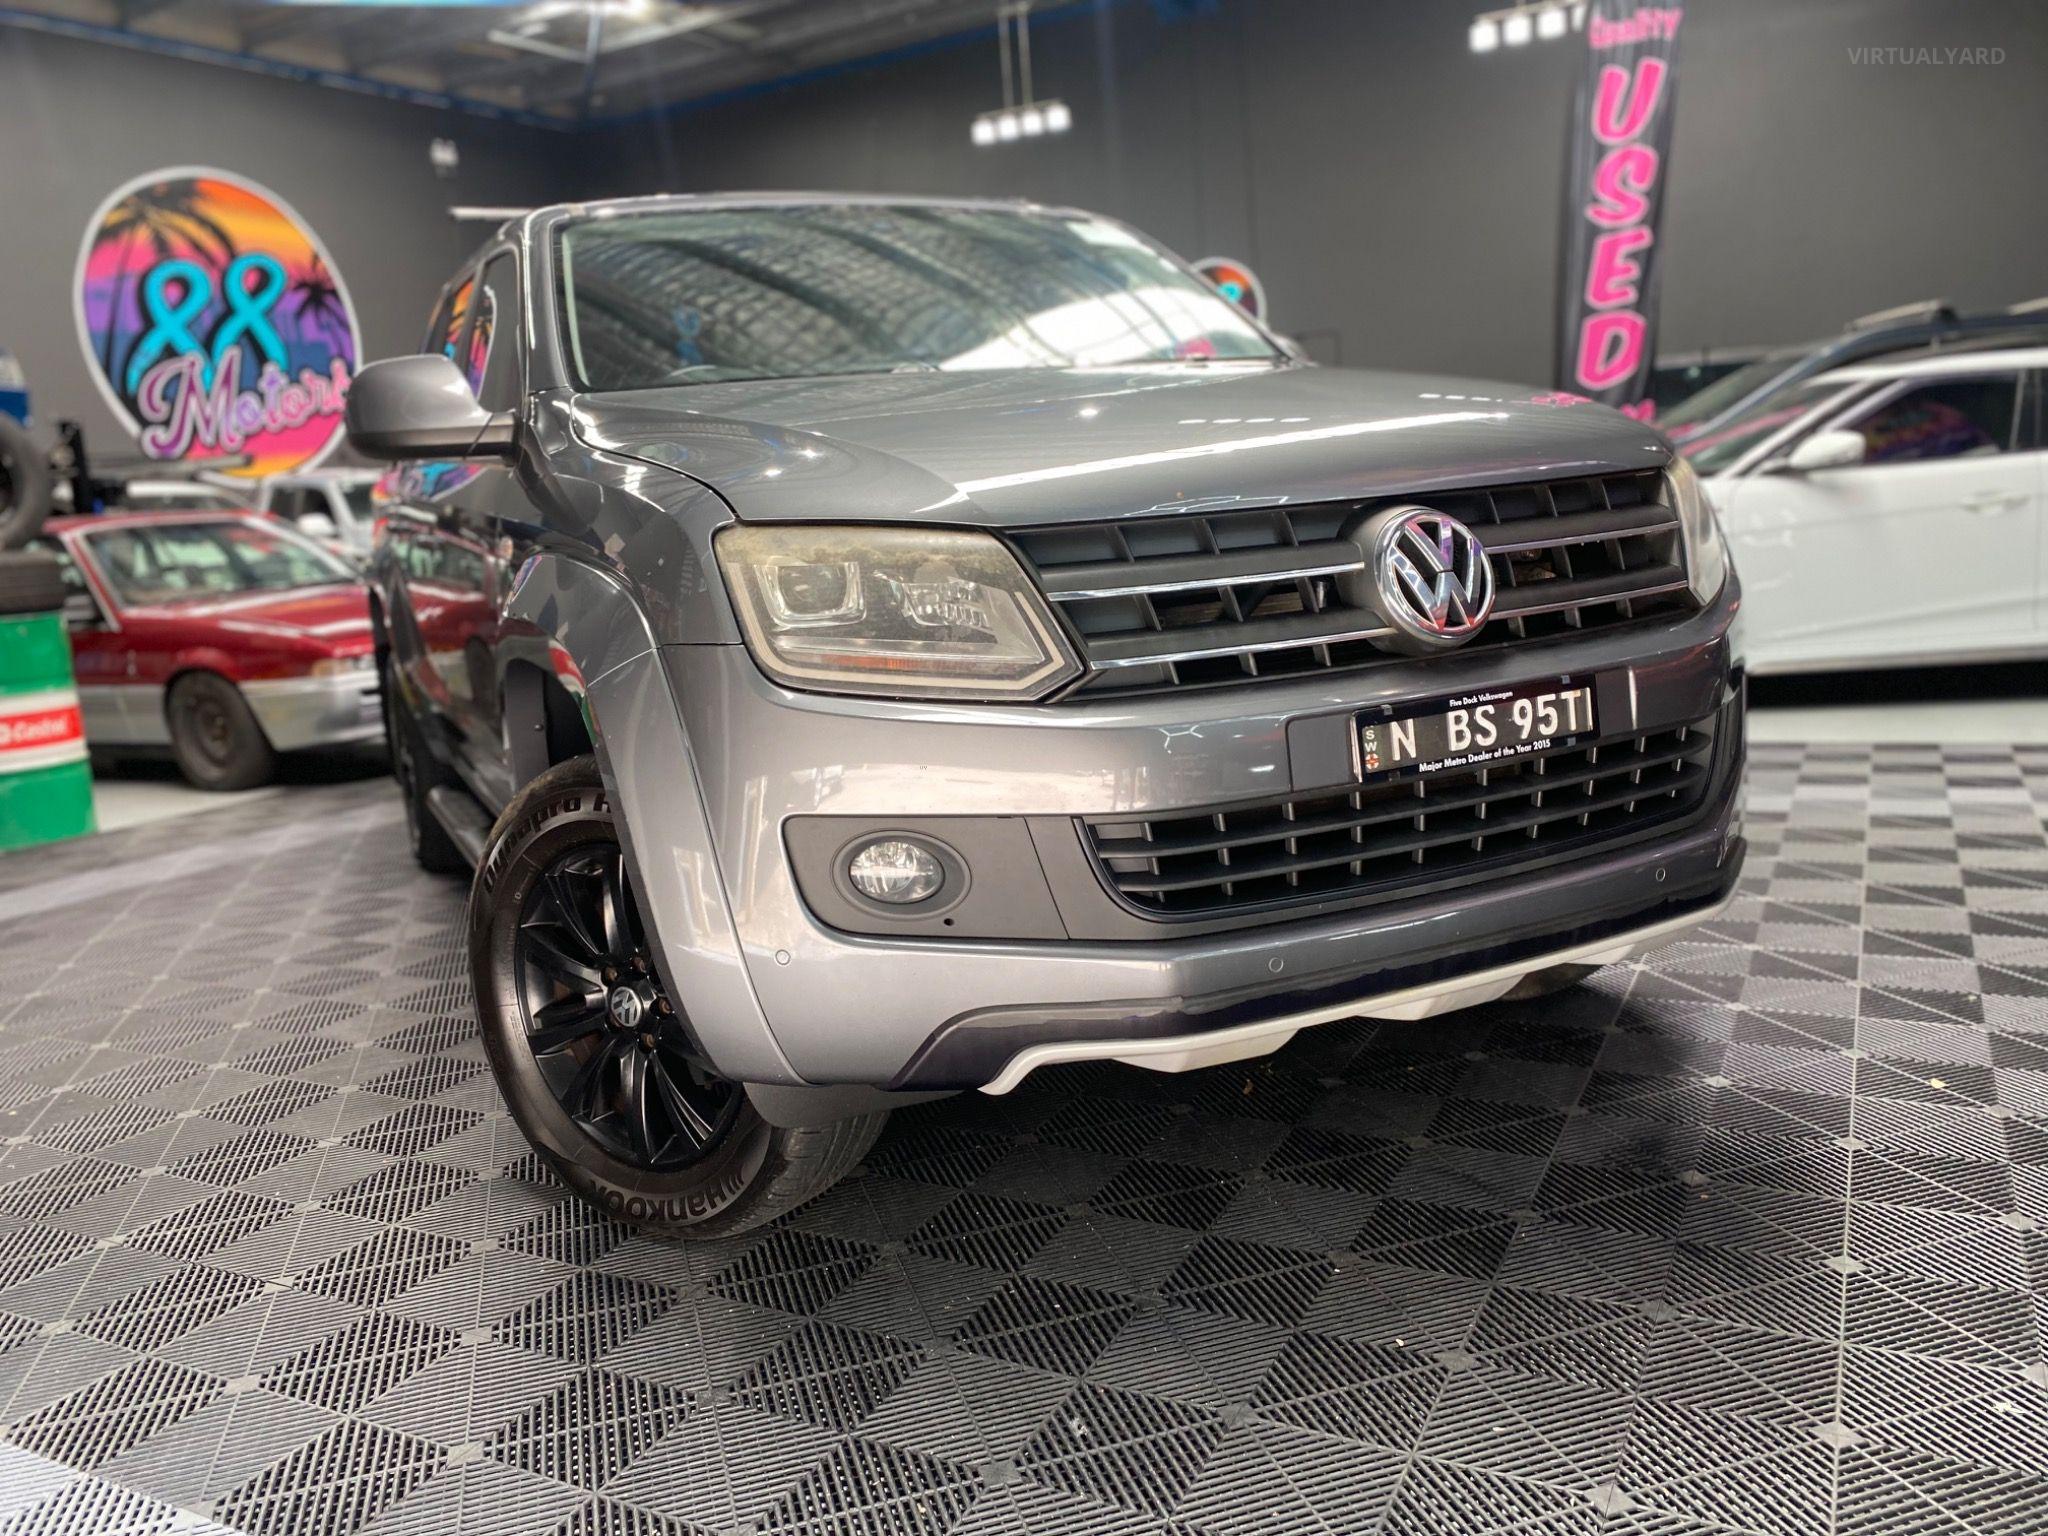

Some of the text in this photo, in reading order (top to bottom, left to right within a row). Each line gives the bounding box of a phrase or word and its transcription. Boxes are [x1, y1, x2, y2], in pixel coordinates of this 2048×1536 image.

[1576, 56, 1667, 391] USED
[125, 253, 289, 398] 88
[1449, 691, 1513, 707] Five Dock Volkswagen
[1446, 704, 1497, 752] BS
[1418, 738, 1551, 772] Major Metro Dealer of the Year 2015
